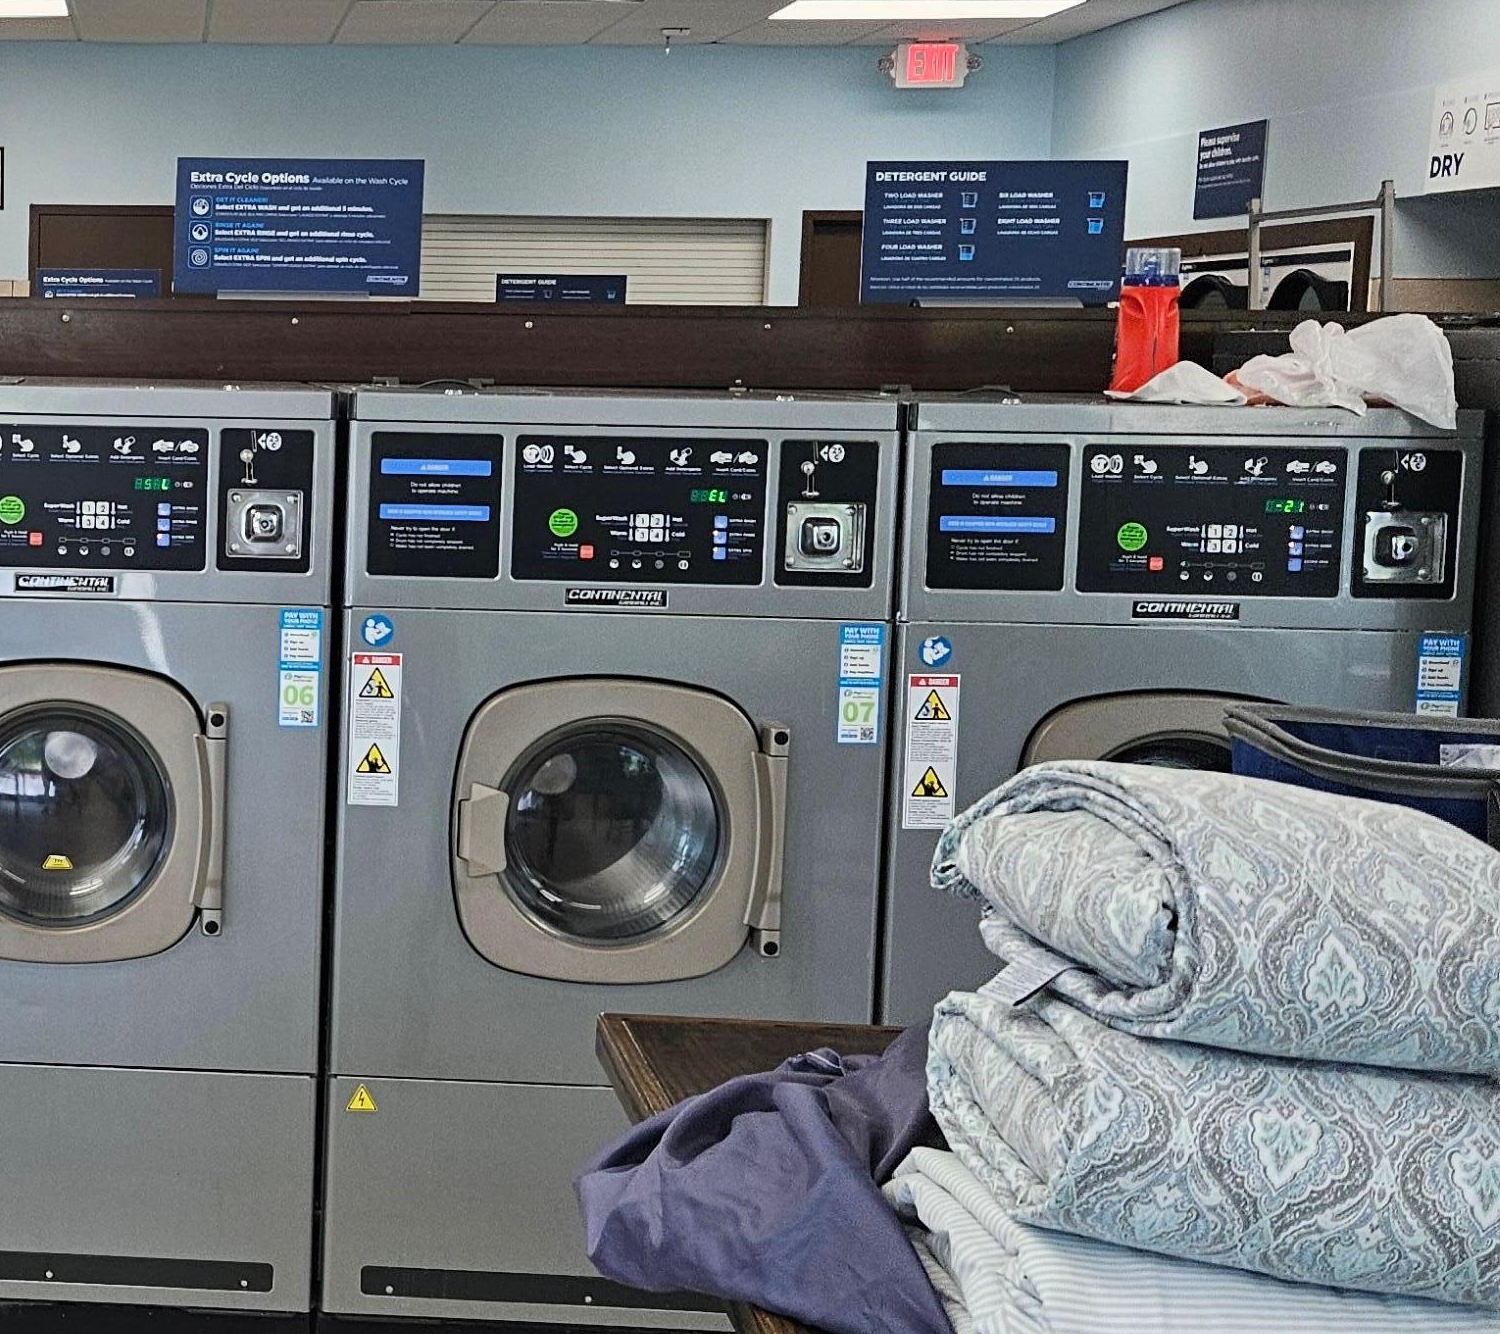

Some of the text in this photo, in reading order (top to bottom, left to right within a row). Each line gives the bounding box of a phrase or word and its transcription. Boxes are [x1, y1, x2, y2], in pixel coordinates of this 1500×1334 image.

[908, 45, 959, 82] EXIT
[1201, 132, 1240, 148] Please supervise
[1430, 152, 1465, 179] DRY
[191, 172, 223, 183] Extra
[225, 172, 259, 185] Cycle
[261, 173, 310, 185] Options
[312, 177, 343, 185] Available
[389, 178, 409, 186] Cycle
[876, 172, 987, 182] DETERGENT GUIDE
[1228, 529, 1234, 537] 2
[1212, 543, 1218, 551] 3
[18, 576, 109, 587] CONTINENTAL
[568, 590, 662, 601] CONTINENTAL
[1136, 603, 1234, 614] CONTINENTAL
[845, 627, 880, 635] PAY WITH
[1423, 638, 1460, 648] PAY WITH
[284, 685, 314, 706] 06
[843, 702, 875, 723] 07
